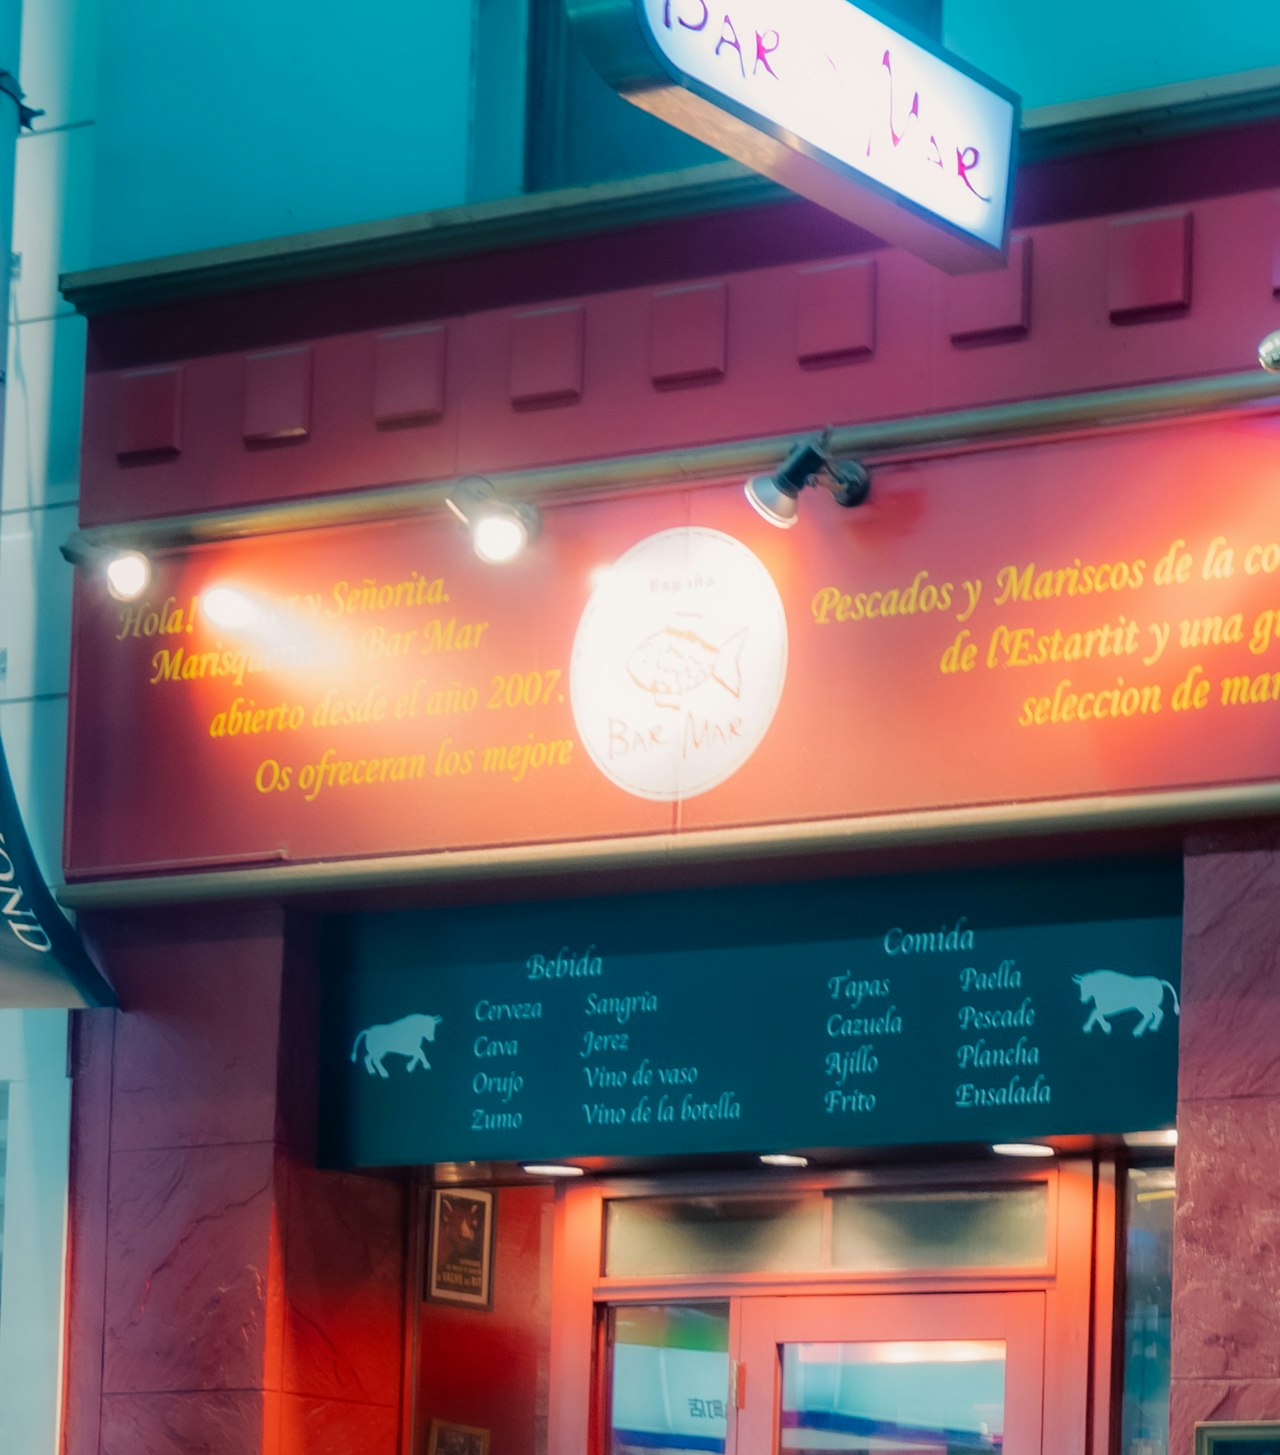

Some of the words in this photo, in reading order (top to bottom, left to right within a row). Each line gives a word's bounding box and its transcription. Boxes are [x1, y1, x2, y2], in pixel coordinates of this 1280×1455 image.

[811, 570, 954, 625] Pescados
[956, 577, 982, 622] y
[994, 557, 1146, 607] Mariscos
[1153, 538, 1194, 588] de
[1200, 535, 1235, 581] la
[116, 596, 197, 640] Hola!
[360, 625, 416, 662] Bar
[420, 617, 489, 655] Mar
[940, 627, 977, 675] de
[1142, 620, 1171, 666] y
[1179, 609, 1244, 650] una
[208, 695, 305, 738] abierto
[311, 687, 388, 729] desde
[394, 682, 420, 721] el
[425, 680, 479, 715] año
[485, 668, 566, 711] 2007.
[1018, 677, 1163, 727] seleccion
[1171, 663, 1210, 713] de
[255, 758, 293, 794] Os
[297, 748, 426, 801] ofreceran
[434, 734, 474, 776] los
[482, 731, 575, 783] mejore
[883, 915, 976, 956] Comida
[526, 944, 602, 981] Bebida
[958, 959, 1023, 993] Paella
[827, 969, 890, 1010] Tapas
[474, 999, 543, 1023] Cerveza
[826, 1004, 903, 1039] Cazuela
[473, 1035, 519, 1059] Cava
[579, 1030, 629, 1059] Jerez
[956, 1035, 1041, 1070] Plancha
[582, 1066, 627, 1089] Vino
[631, 1057, 654, 1086] de
[657, 1064, 699, 1086] vaso
[824, 1043, 879, 1087] Ajillo
[472, 1071, 524, 1105] Orujo
[824, 1088, 877, 1114] Frito
[955, 1074, 1052, 1109] Ensalada
[471, 1109, 523, 1131] Zumo
[581, 1102, 627, 1126] Vino
[631, 1095, 653, 1123] de
[656, 1094, 675, 1123] la
[680, 1090, 742, 1121] botella
